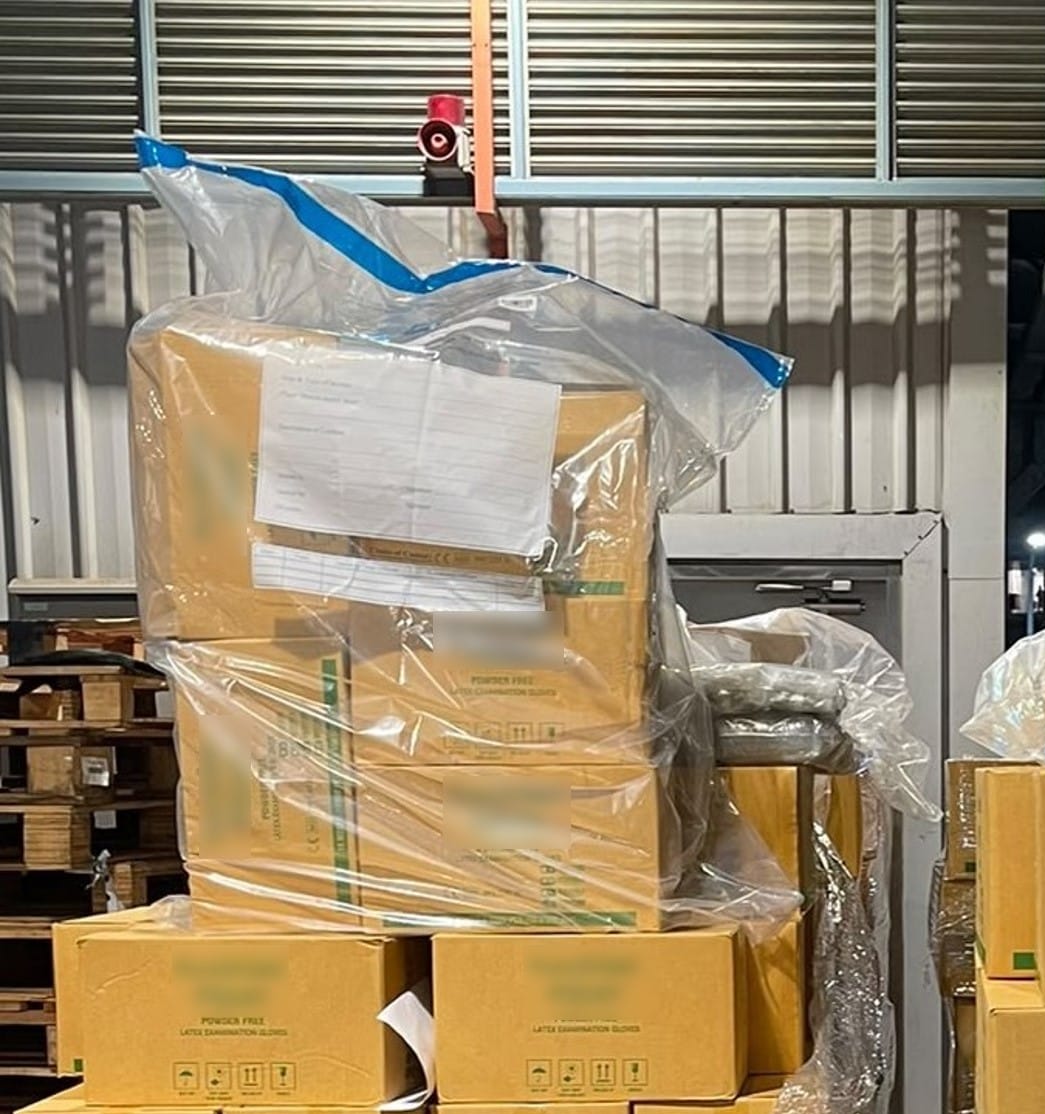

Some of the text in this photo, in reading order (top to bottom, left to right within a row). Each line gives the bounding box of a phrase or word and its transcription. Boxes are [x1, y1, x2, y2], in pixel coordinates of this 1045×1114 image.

[201, 1017, 265, 1026] POWDER FREE
[180, 1028, 203, 1036] LATEX
[204, 1028, 257, 1036] EXAMINATION
[532, 1025, 641, 1033] LATEX EXAMINATION GLOVES
